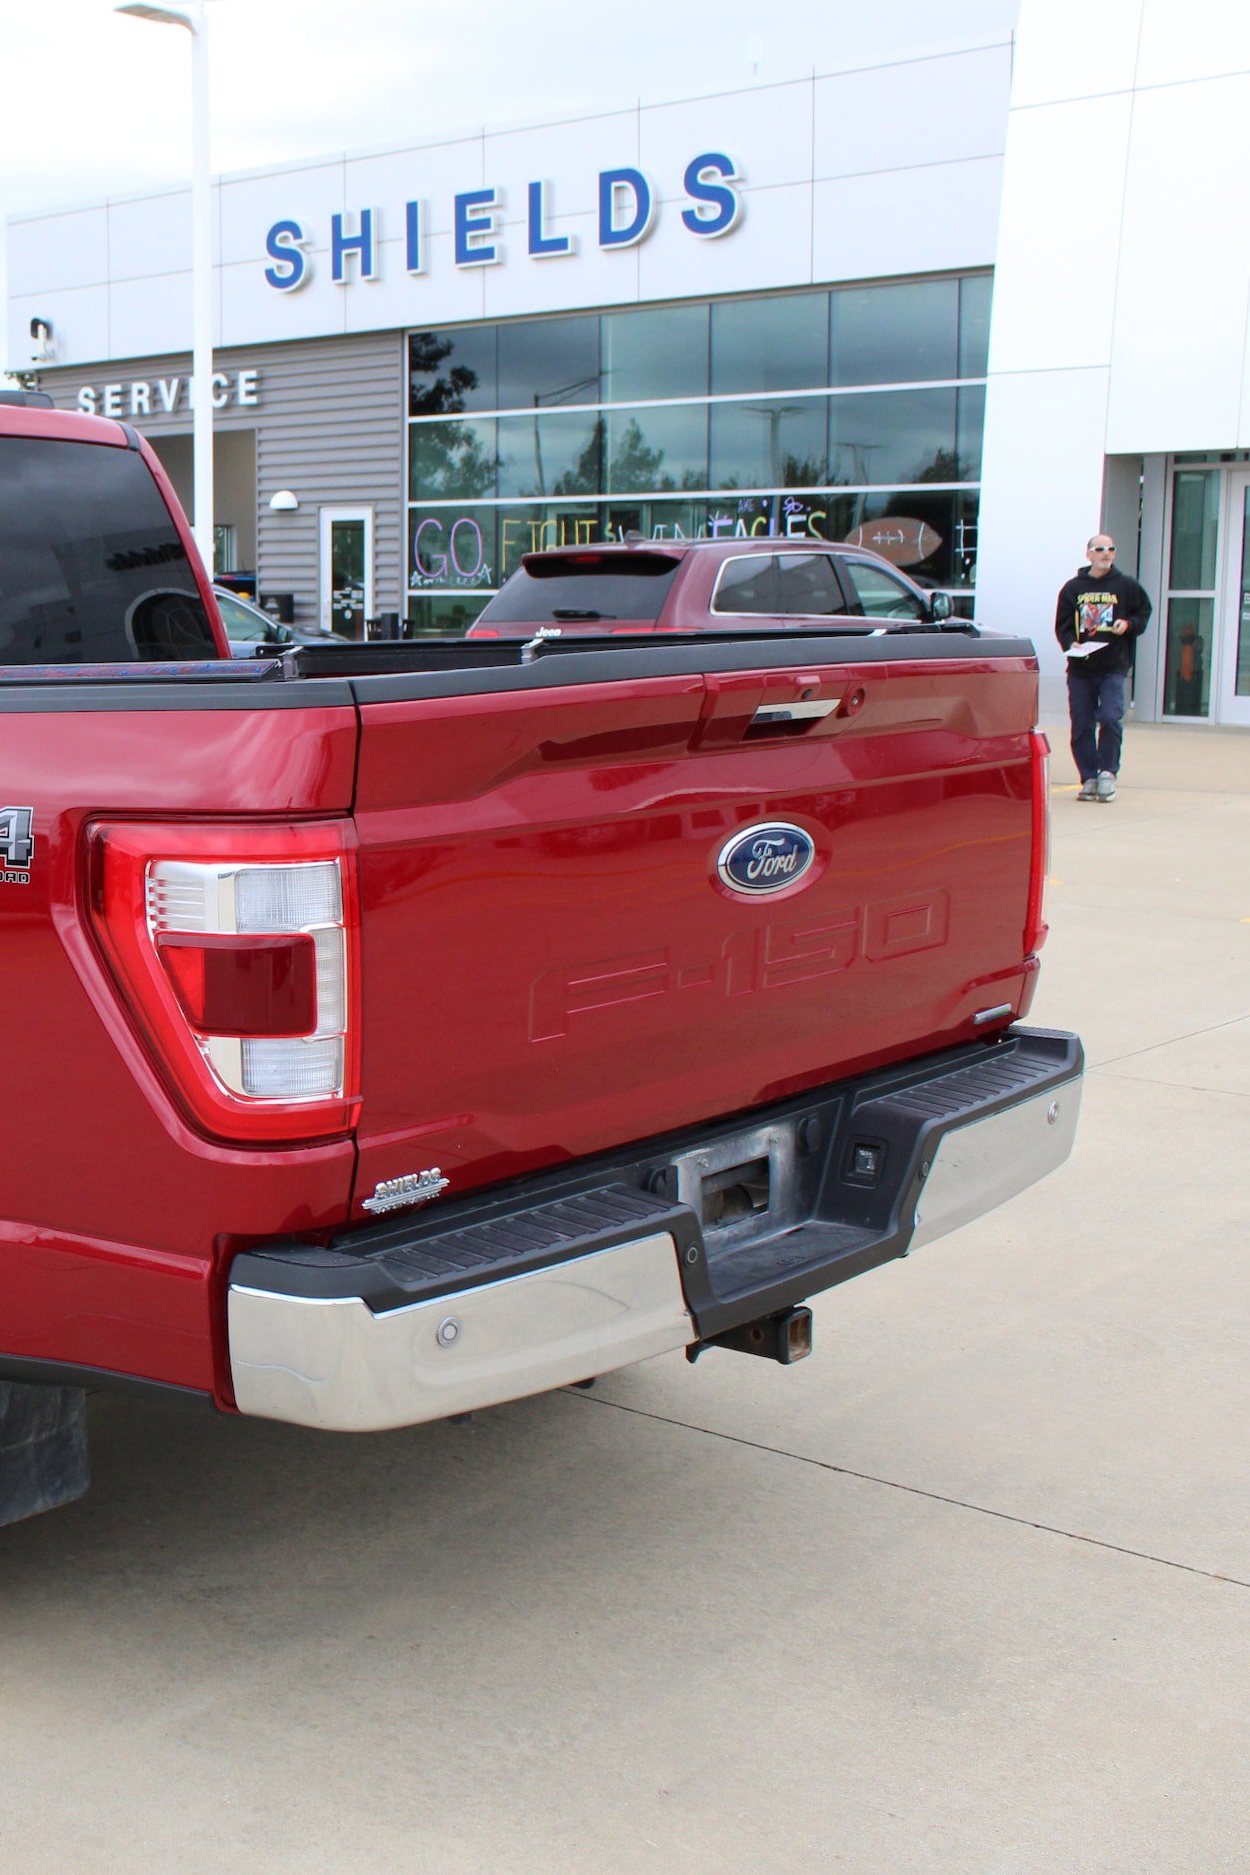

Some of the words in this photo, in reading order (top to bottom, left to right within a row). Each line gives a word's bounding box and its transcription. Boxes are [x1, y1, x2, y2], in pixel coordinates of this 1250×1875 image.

[264, 153, 742, 291] SHIELDS
[414, 518, 483, 577] GO
[746, 838, 798, 879] Ford
[528, 889, 950, 1043] F-150
